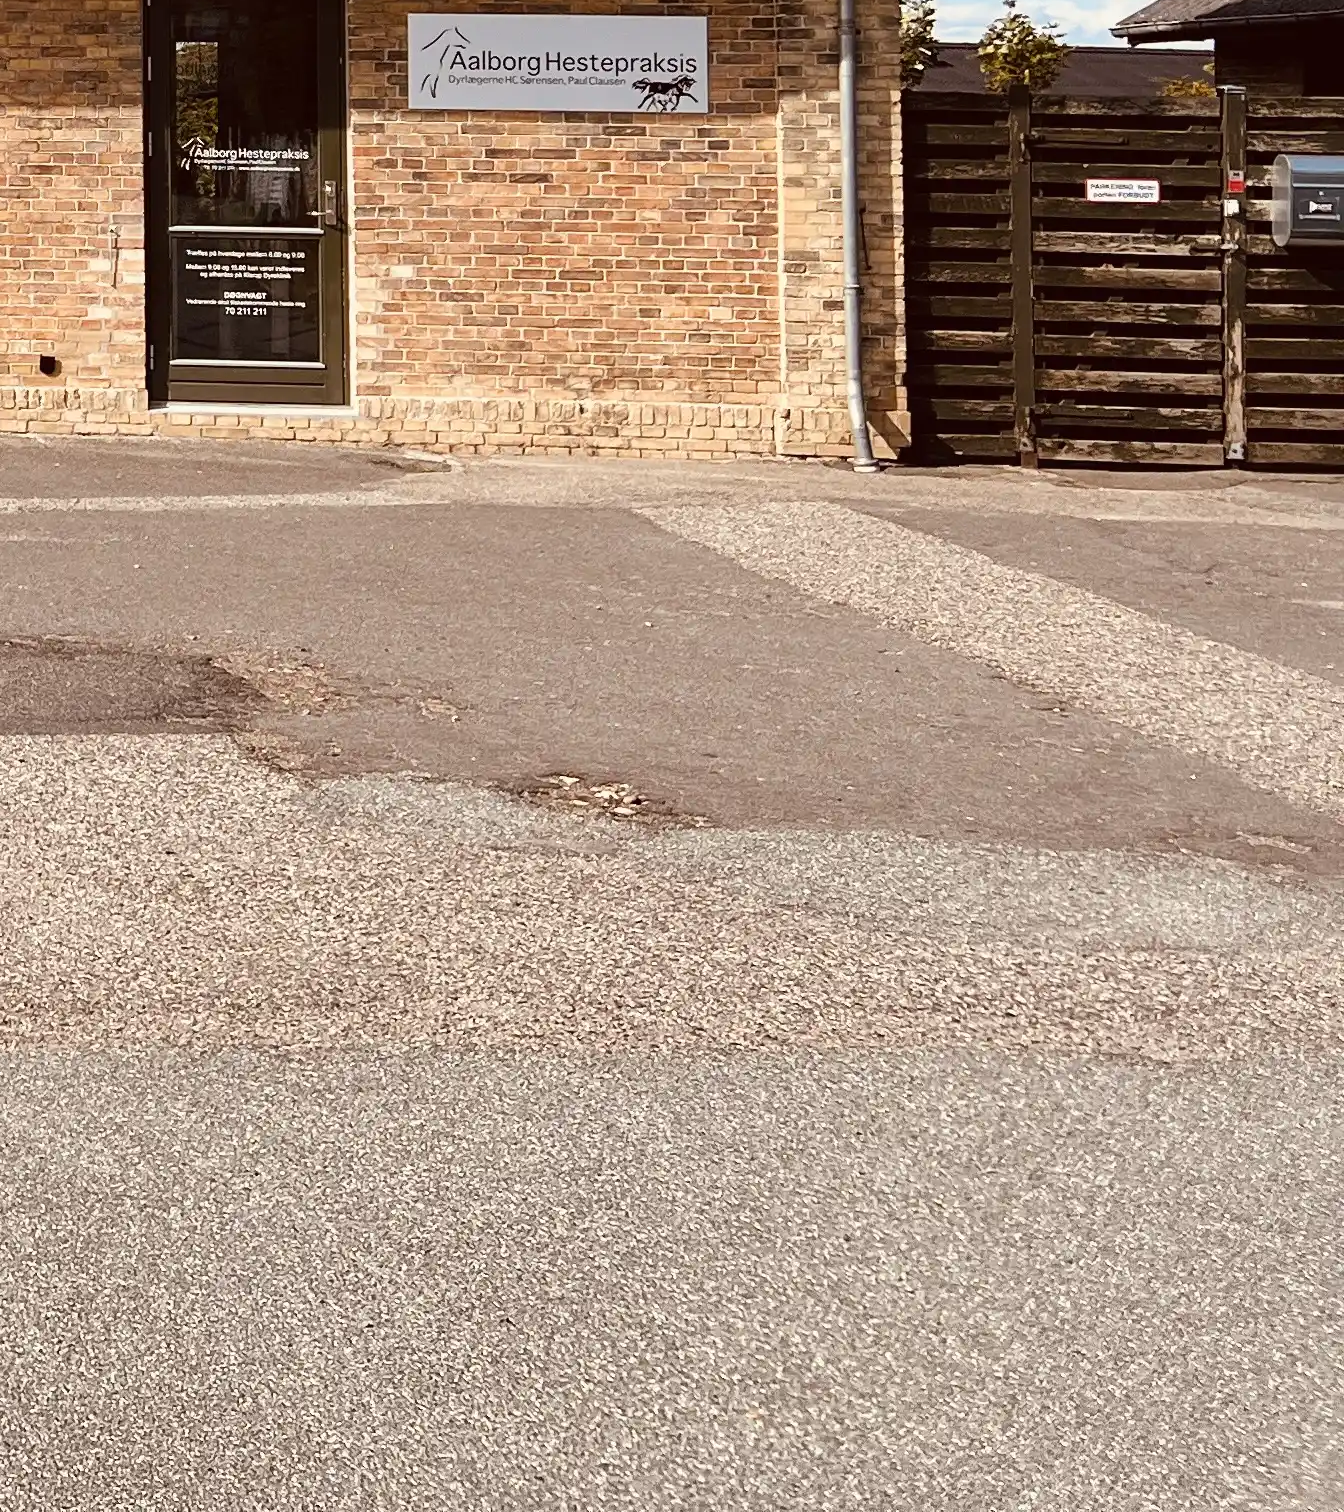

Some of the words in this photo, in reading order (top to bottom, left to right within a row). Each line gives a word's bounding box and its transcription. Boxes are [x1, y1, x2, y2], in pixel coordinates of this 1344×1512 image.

[449, 50, 541, 76] Aalborg
[546, 51, 698, 76] Hestepraksis
[448, 74, 504, 86] Dyrlægerne
[568, 76, 588, 85] Paul
[588, 76, 626, 86] Clausen
[194, 148, 238, 160] Aalborg
[238, 148, 310, 160] Hestepraksis
[225, 307, 236, 315] 70
[236, 307, 251, 315] 211
[252, 307, 267, 316] 211
